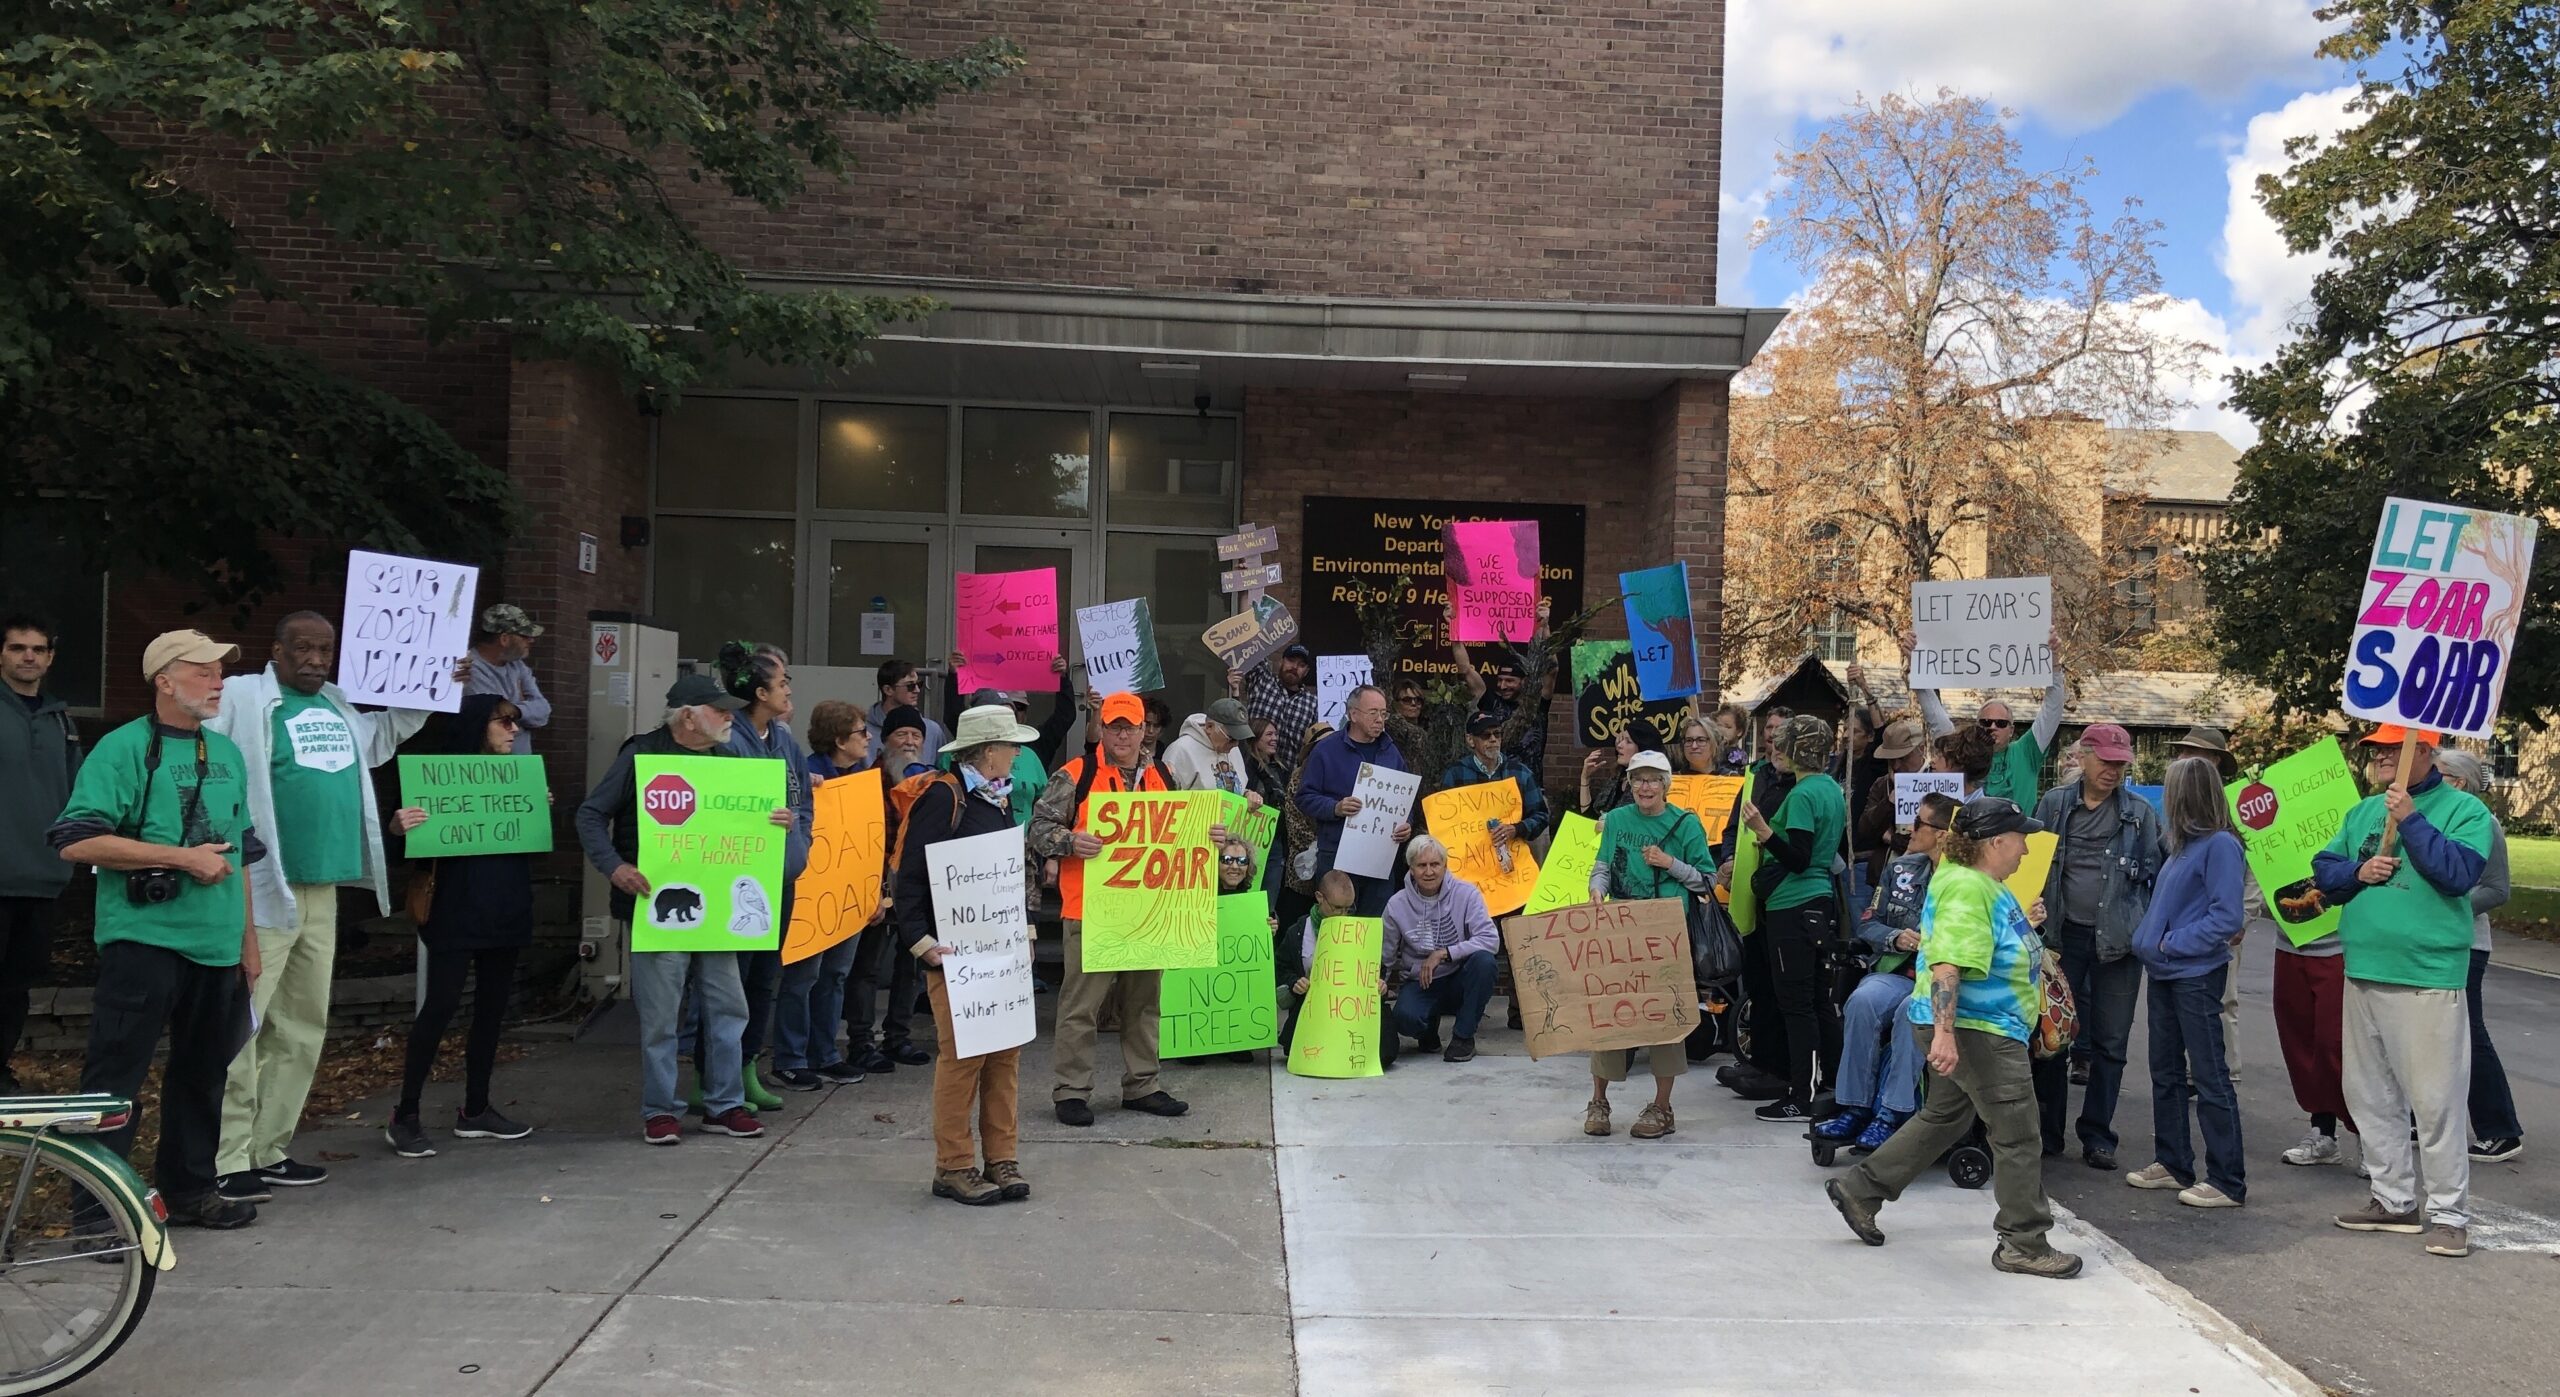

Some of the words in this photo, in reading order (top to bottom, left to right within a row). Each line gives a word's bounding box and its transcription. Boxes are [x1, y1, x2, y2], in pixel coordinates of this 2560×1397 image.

[1373, 512, 1413, 530] New
[1385, 537, 1443, 555] Depart
[2376, 504, 2472, 573] LET
[1312, 557, 1444, 576] Environmental
[1477, 554, 1503, 570] WE
[1480, 571, 1508, 586] ARE
[1024, 594, 1050, 609] CO2
[1406, 589, 1417, 604] 9
[1463, 589, 1532, 606] SUPPOSED
[1918, 594, 1953, 622] LET
[1966, 591, 2041, 621] ZOAR'S
[2358, 570, 2490, 642] ZOAR
[1078, 600, 1134, 624] RESPECT
[1463, 607, 1481, 618] TO
[1488, 606, 1535, 619] OUTLIVE
[1014, 623, 1058, 637] METHANE
[1207, 621, 1250, 648] Save
[1259, 614, 1296, 646] Valley
[1487, 619, 1516, 635] YOU
[1006, 650, 1053, 662] OXYGEN
[1086, 649, 1137, 677] ELDERS
[1637, 645, 1669, 662] LET
[1914, 648, 1981, 676] TREES
[1988, 643, 2052, 677] SOAR
[1402, 658, 1475, 675] Delawa
[2347, 630, 2500, 732] SOAR
[1613, 698, 1644, 719] the
[295, 721, 348, 734] RESTORE
[298, 733, 349, 744] HUMBOLDT
[1357, 762, 1414, 797] Protect
[1912, 780, 1932, 792] Zoar
[1934, 779, 1959, 793] Valley
[646, 790, 694, 810] STOP
[2239, 791, 2274, 821] STOP
[2281, 763, 2346, 802] LOGGING
[414, 795, 475, 815] THESE
[479, 794, 534, 814] TREES
[1364, 793, 1407, 817] What's
[1434, 790, 1520, 820] SAVING
[1897, 798, 1920, 815] Fore
[439, 822, 485, 845] CAN'T
[493, 818, 521, 842] GO!
[1094, 800, 1188, 846] SAVE
[1451, 821, 1485, 838] TREE
[2252, 829, 2288, 855] THEY
[2296, 808, 2339, 835] NEED
[654, 833, 708, 850] THEY
[720, 835, 767, 853] NEED
[1616, 829, 1632, 846] BAN
[2264, 852, 2274, 865] A
[2294, 823, 2339, 853] HOME
[670, 849, 681, 864] A
[701, 851, 752, 865] HOME
[802, 822, 883, 876] OAR
[1447, 840, 1521, 874] SAVIG
[946, 863, 1002, 892] Protect
[1103, 846, 1210, 890] ZOAR
[791, 874, 880, 949] SOAR
[952, 906, 976, 926] NO
[1537, 904, 1638, 941] ZOAR
[974, 938, 999, 953] Want
[1561, 932, 1683, 972] VALLEY
[957, 964, 996, 986] Shame
[999, 968, 1012, 978] on
[1189, 969, 1261, 1009] NOT
[962, 1001, 998, 1019] What
[1004, 1000, 1015, 1011] is
[1328, 993, 1378, 1022] HOME
[1587, 998, 1666, 1029] LOG
[1160, 1006, 1271, 1050] TREES
